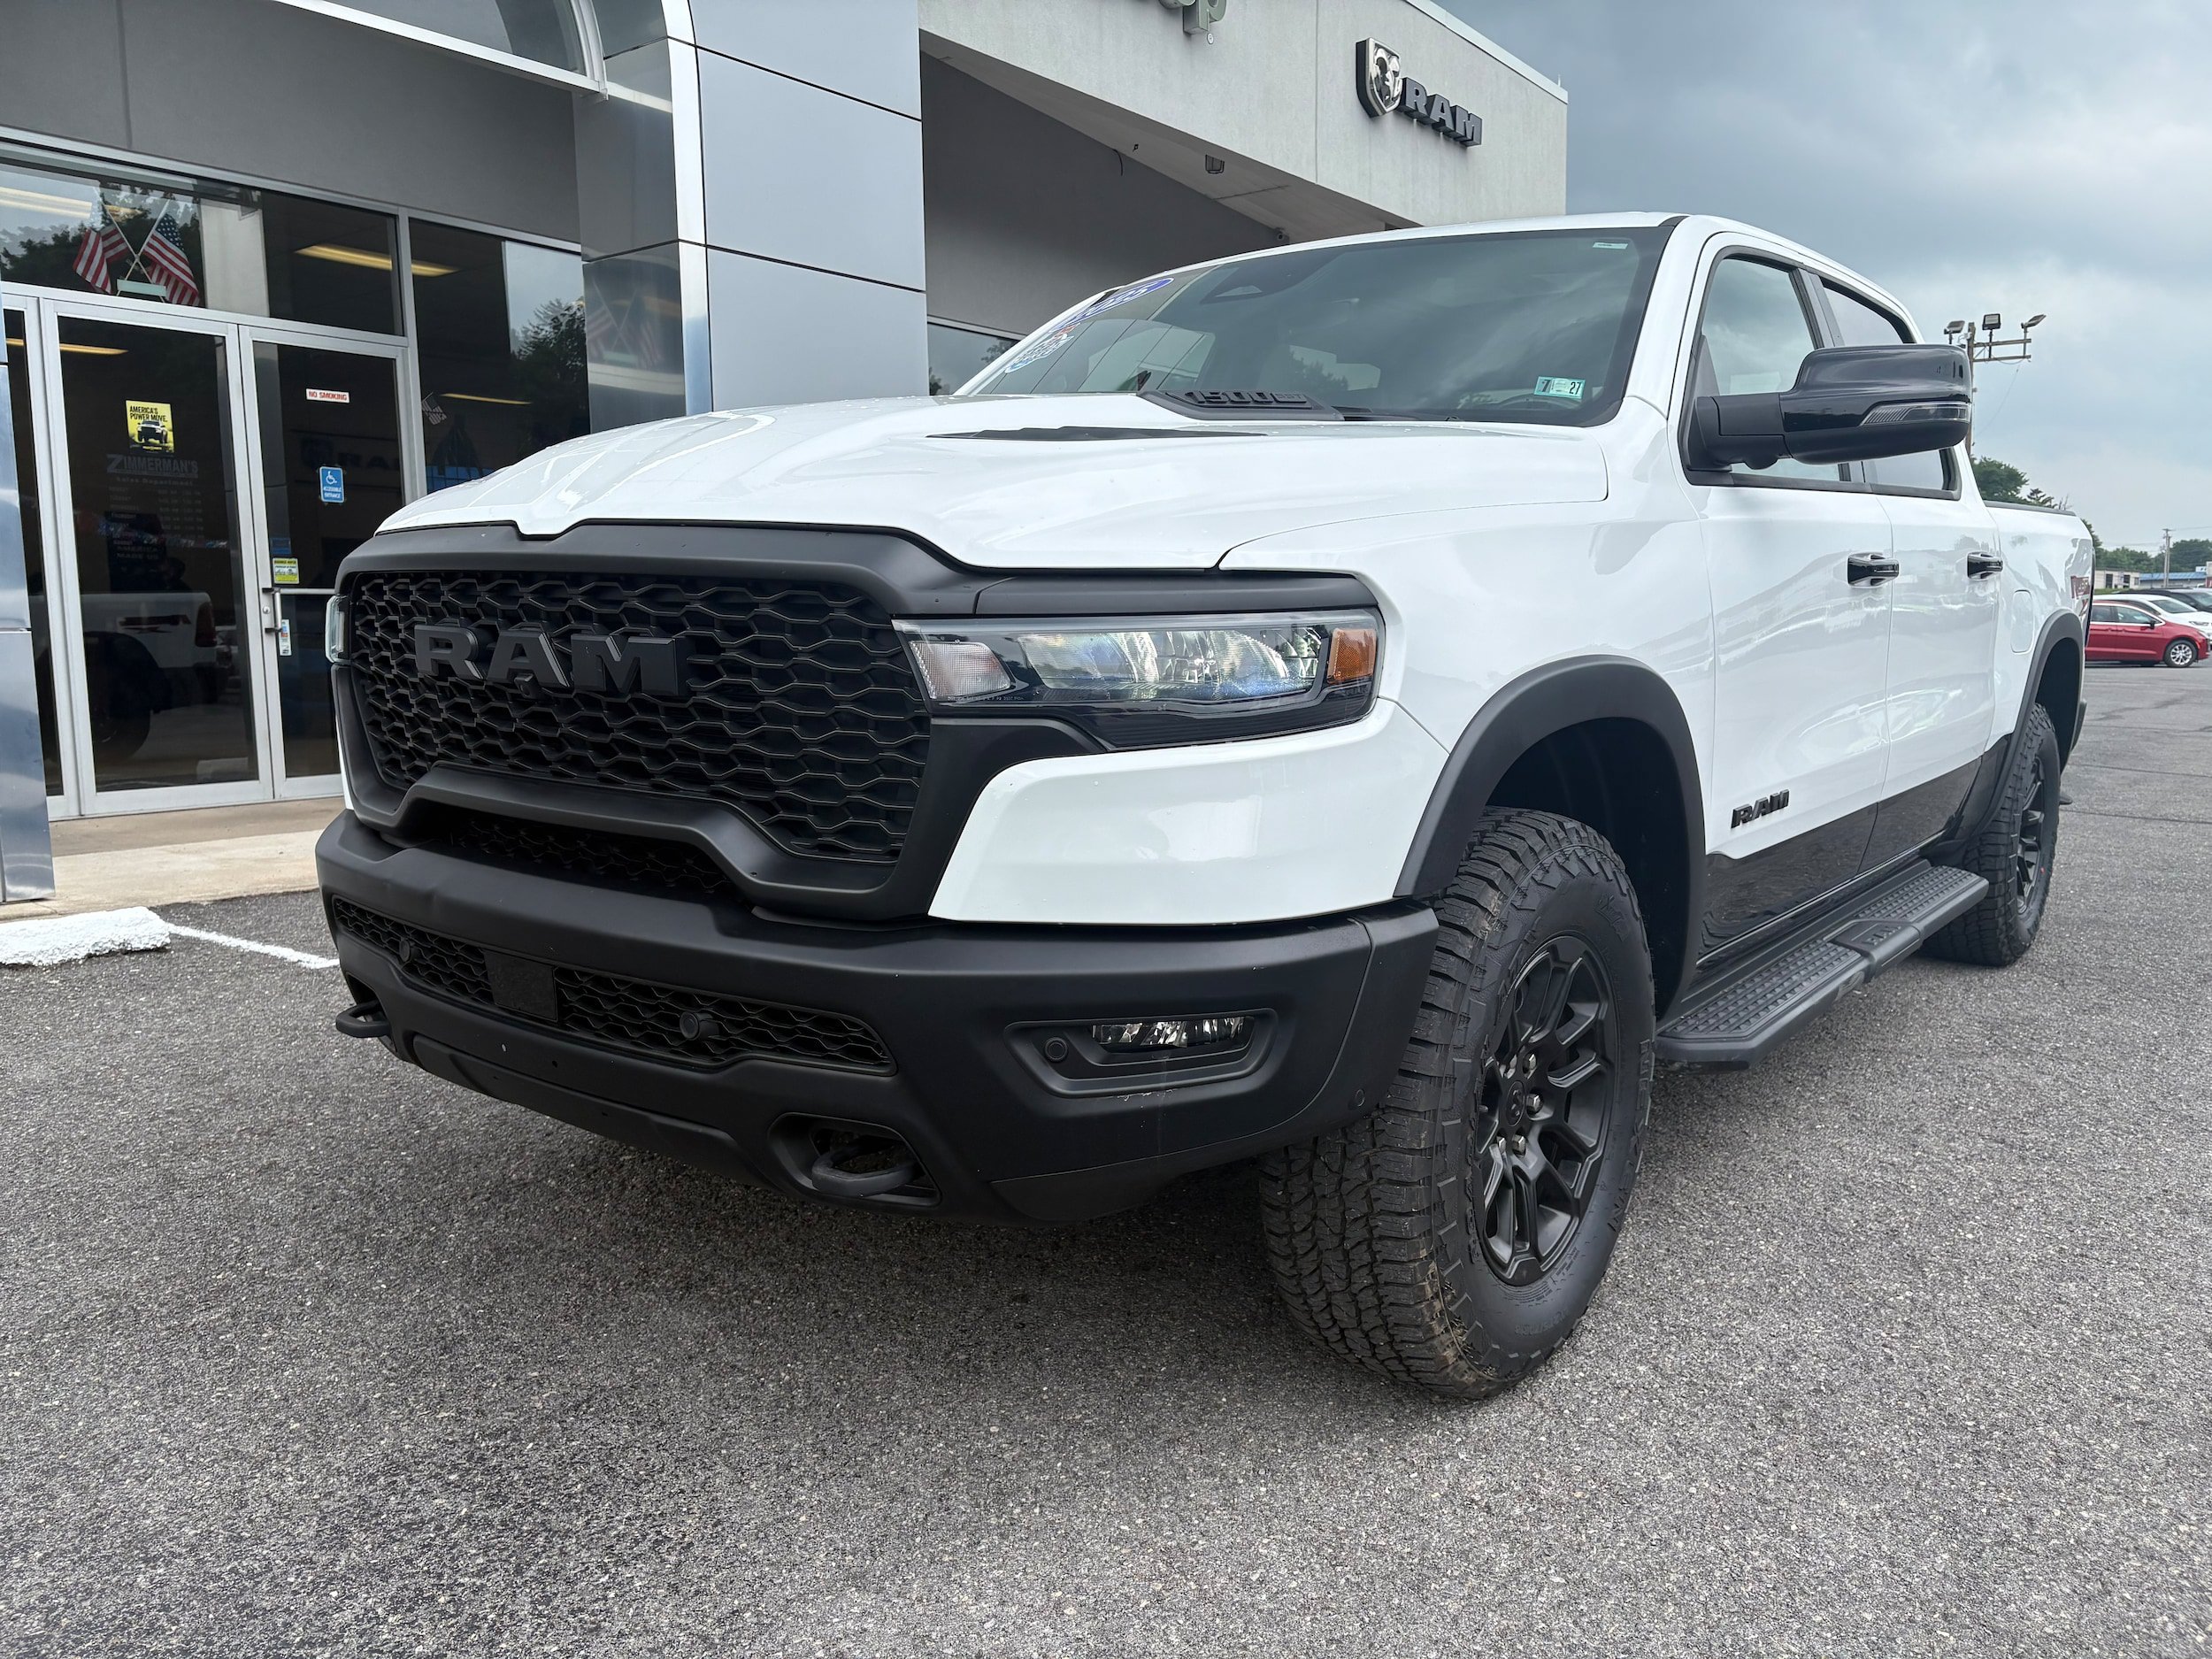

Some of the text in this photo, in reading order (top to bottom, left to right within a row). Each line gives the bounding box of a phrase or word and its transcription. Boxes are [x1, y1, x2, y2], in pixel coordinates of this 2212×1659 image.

[1400, 77, 1482, 146] RAM
[1541, 379, 1582, 395] 7 27
[319, 392, 347, 401] SMOKING
[1185, 391, 1273, 404] 1500
[129, 405, 158, 414] AMERICA'S
[106, 454, 198, 475] ZIMMERMAN'S
[414, 624, 680, 696] RAM
[1731, 788, 1789, 828] RAM
